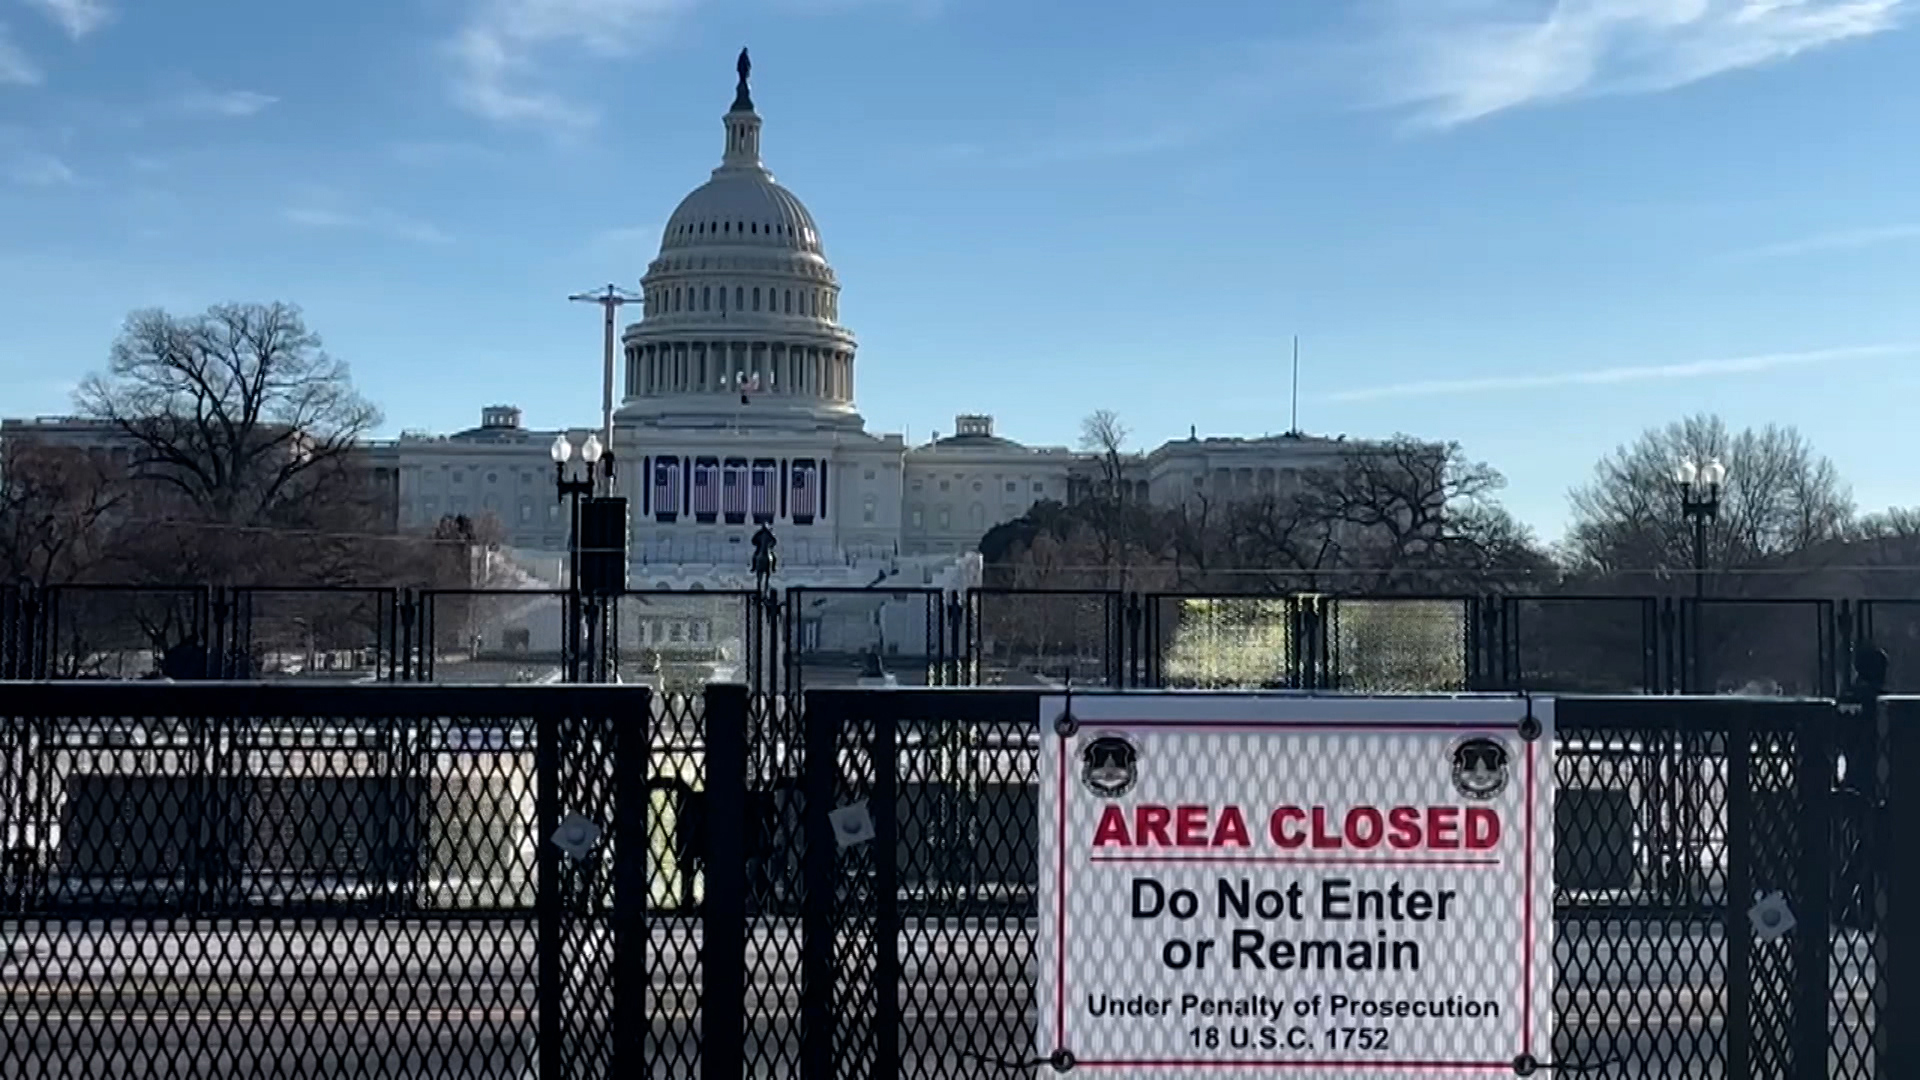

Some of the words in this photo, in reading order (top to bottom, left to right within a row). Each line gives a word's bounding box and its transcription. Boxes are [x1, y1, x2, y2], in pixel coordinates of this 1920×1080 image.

[1093, 806, 1250, 847] AREA
[1270, 807, 1501, 850] CLOSED
[1132, 878, 1199, 920] Do
[1218, 878, 1303, 920] Not
[1322, 879, 1455, 920] Enter
[1162, 936, 1215, 970] or
[1232, 929, 1420, 970] Remain
[1088, 995, 1172, 1017] Under
[1181, 995, 1284, 1022] Penalty
[1294, 995, 1322, 1018] of
[1331, 996, 1499, 1019] Prosecution
[1190, 1027, 1219, 1049] 18
[1231, 1028, 1314, 1050] U.S.C.
[1326, 1028, 1390, 1050] 1752
